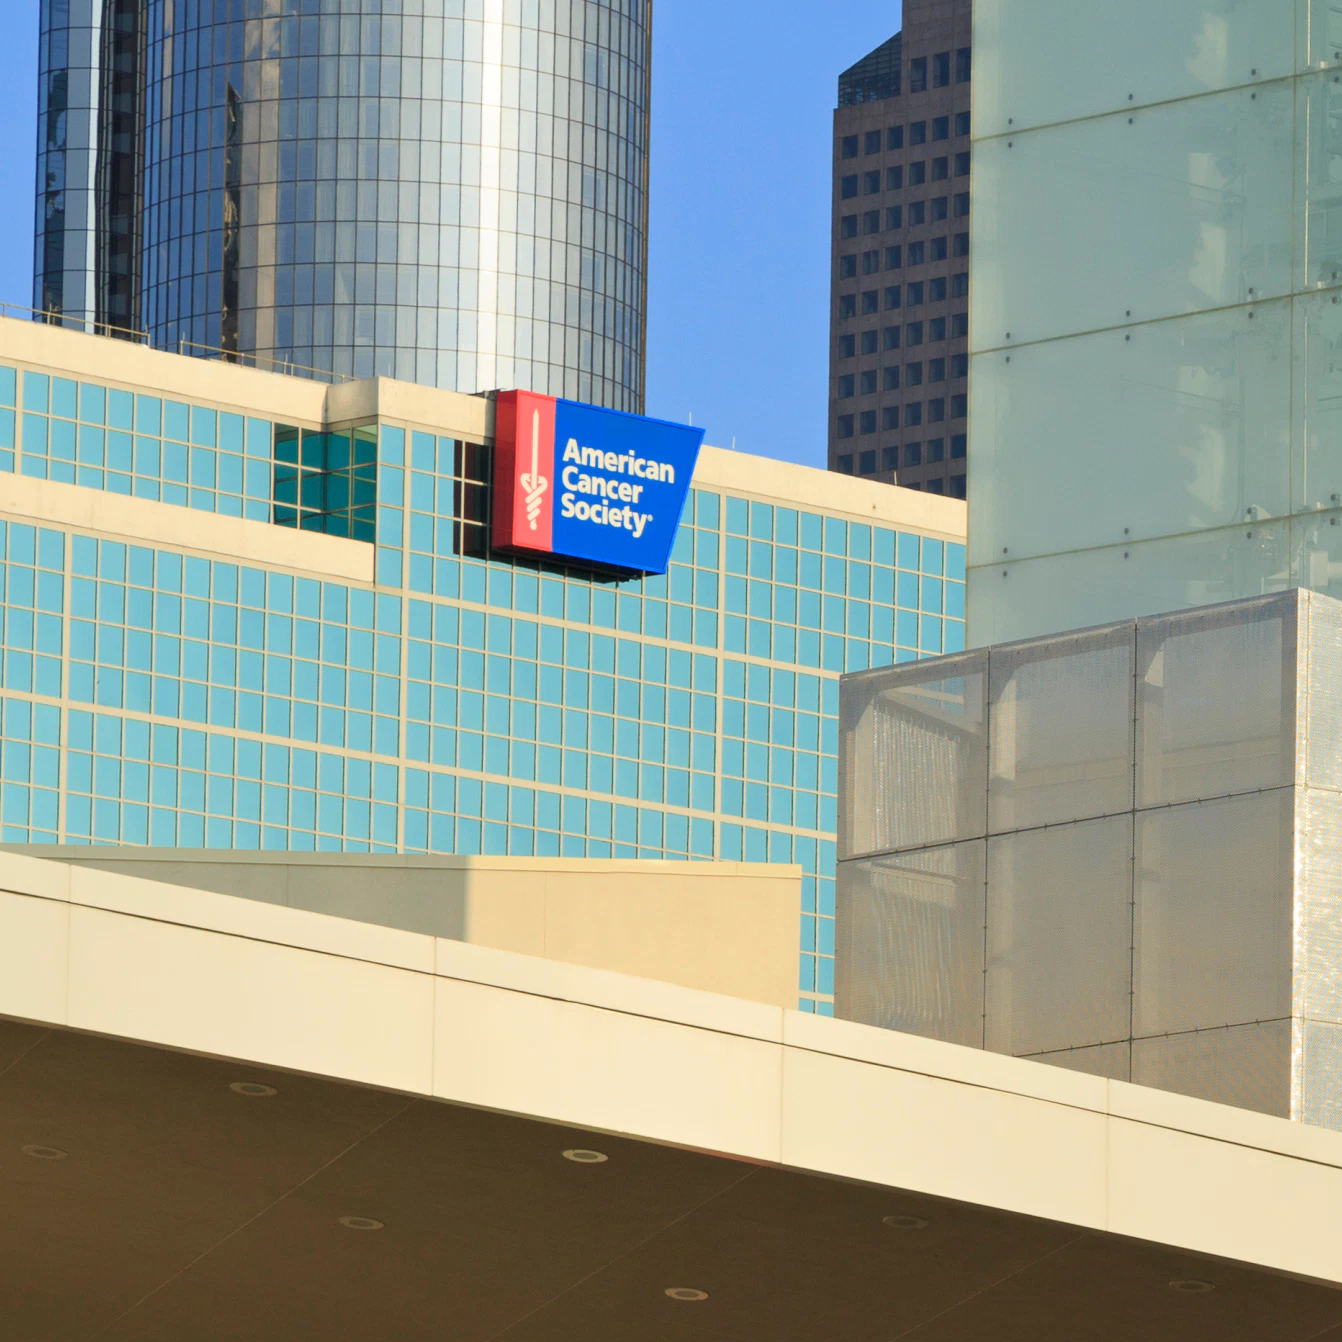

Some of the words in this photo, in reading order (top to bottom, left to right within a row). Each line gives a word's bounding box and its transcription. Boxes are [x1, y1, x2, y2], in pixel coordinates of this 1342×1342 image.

[562, 438, 675, 484] American
[561, 466, 644, 504] Cancer
[561, 493, 647, 538] Society
